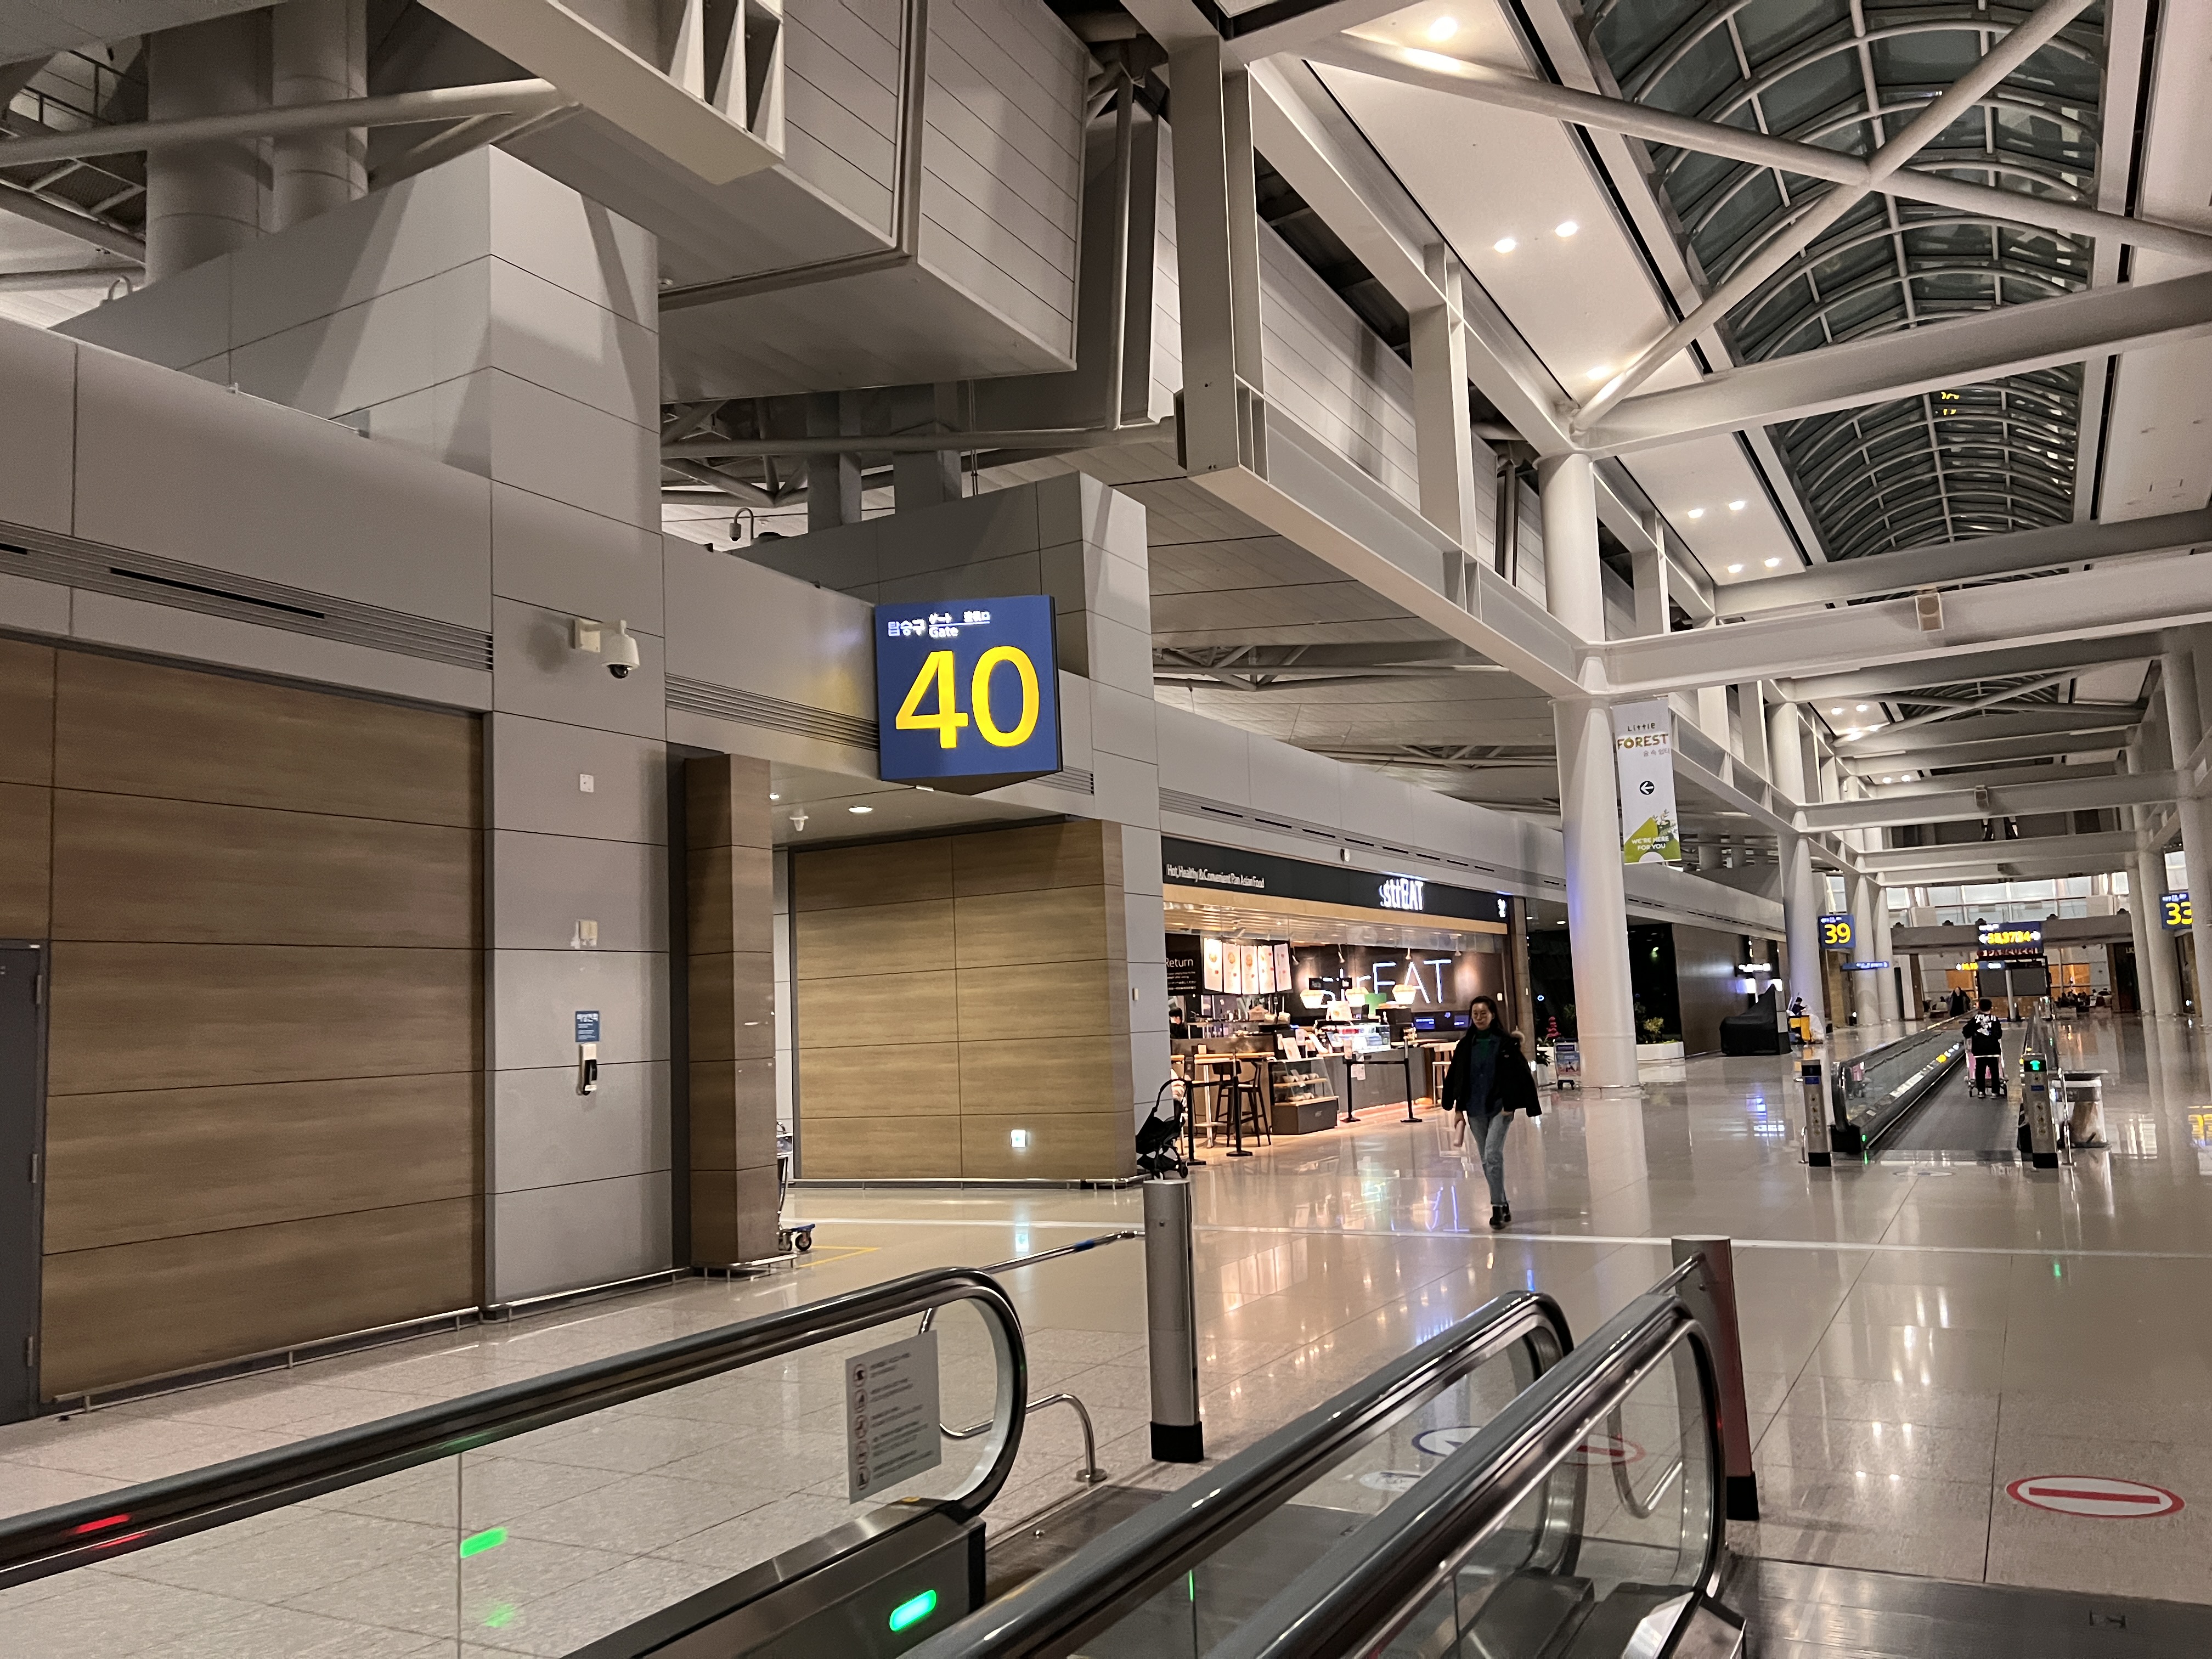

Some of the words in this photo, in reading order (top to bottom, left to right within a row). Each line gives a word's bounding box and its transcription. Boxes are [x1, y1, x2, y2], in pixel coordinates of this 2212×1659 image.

[888, 619, 927, 637] 탑승구
[928, 626, 959, 639] Gate
[896, 645, 1040, 749] 40
[1617, 733, 1669, 751] FOREST
[1824, 923, 1851, 944] 39
[1165, 957, 1194, 968] Return
